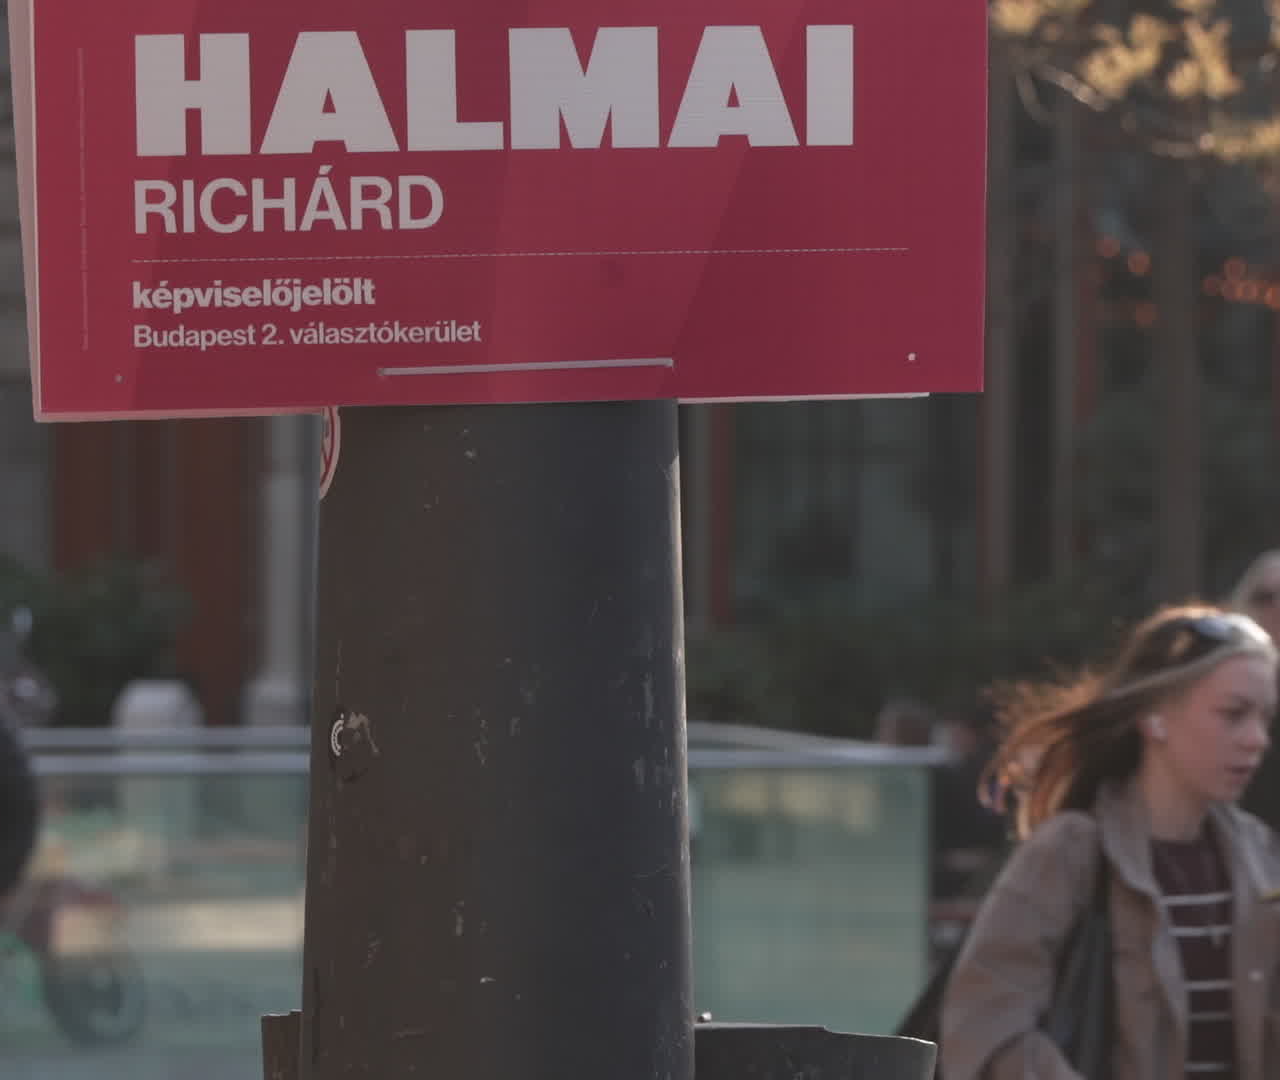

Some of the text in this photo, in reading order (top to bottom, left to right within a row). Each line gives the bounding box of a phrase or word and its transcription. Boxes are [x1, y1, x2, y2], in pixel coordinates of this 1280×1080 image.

[134, 24, 855, 157] HALMAI
[134, 165, 445, 235] RICHÁRD
[133, 276, 376, 313] képviselőjelölt
[134, 318, 482, 350] Budapest 2. választókerület
